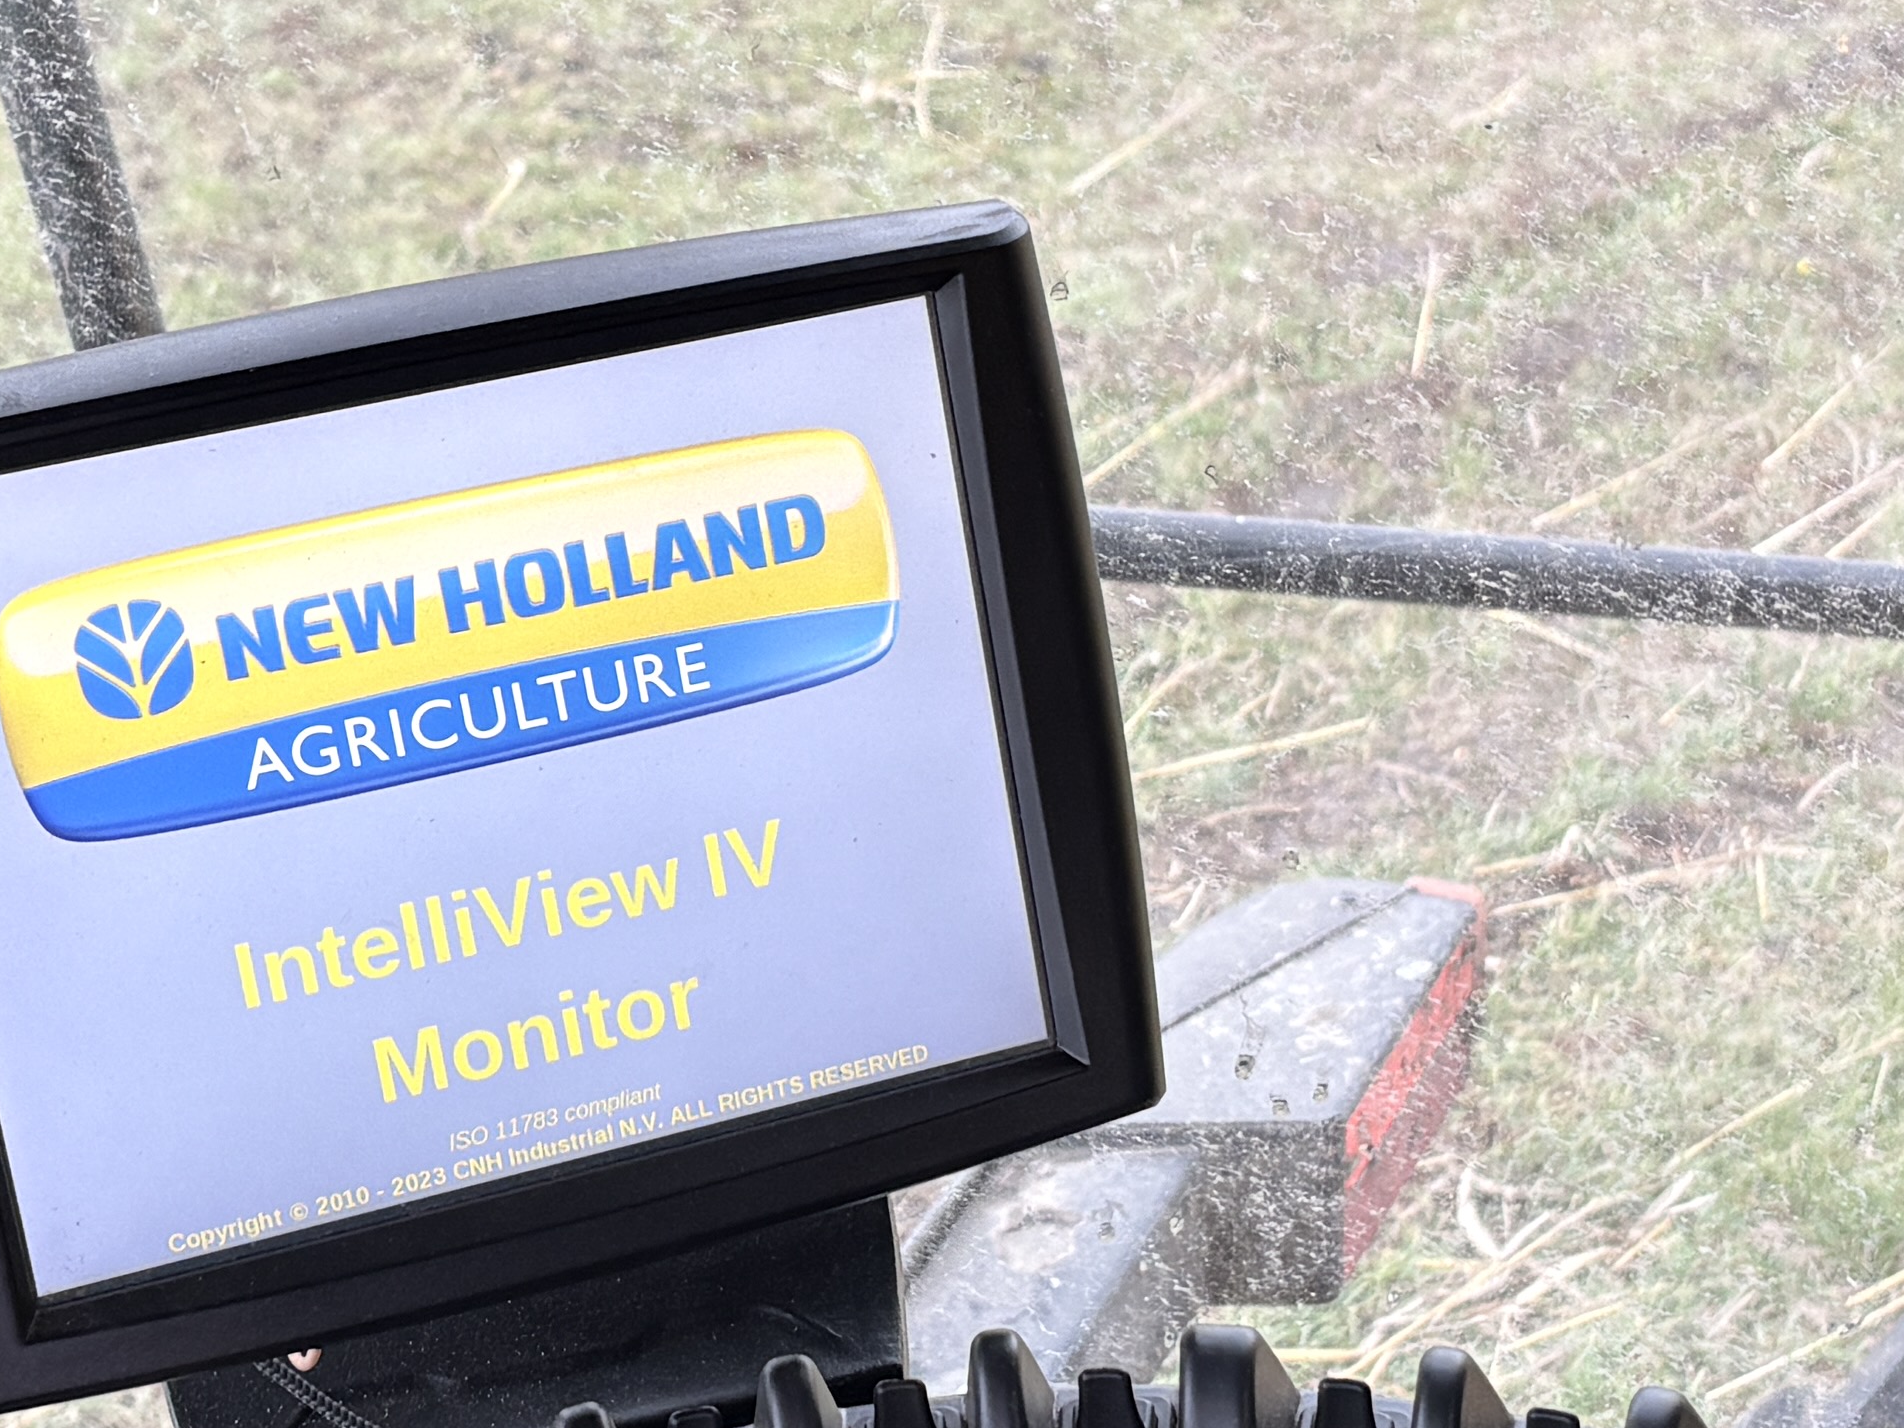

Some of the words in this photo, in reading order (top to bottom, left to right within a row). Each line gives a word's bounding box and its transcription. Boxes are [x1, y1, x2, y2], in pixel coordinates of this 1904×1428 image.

[216, 575, 417, 681] NEW
[438, 494, 826, 634] HOLLAND
[246, 641, 711, 791] AGRICULTURE
[234, 858, 679, 1010] IntelliView
[704, 818, 781, 898] IV
[372, 976, 699, 1104] Monitor
[449, 1125, 489, 1152] ISO
[496, 1109, 559, 1140] 11783
[564, 1082, 662, 1123] compliant
[167, 1208, 284, 1254] Copyright
[315, 1185, 370, 1217] 2010
[391, 1167, 447, 1198] 2023
[453, 1151, 503, 1181] CNH
[509, 1123, 615, 1167] Industrial
[619, 1113, 663, 1139] N.V.
[670, 1101, 714, 1127] ALL
[718, 1075, 805, 1115] RIGHTS
[810, 1044, 929, 1091] RESERVED
